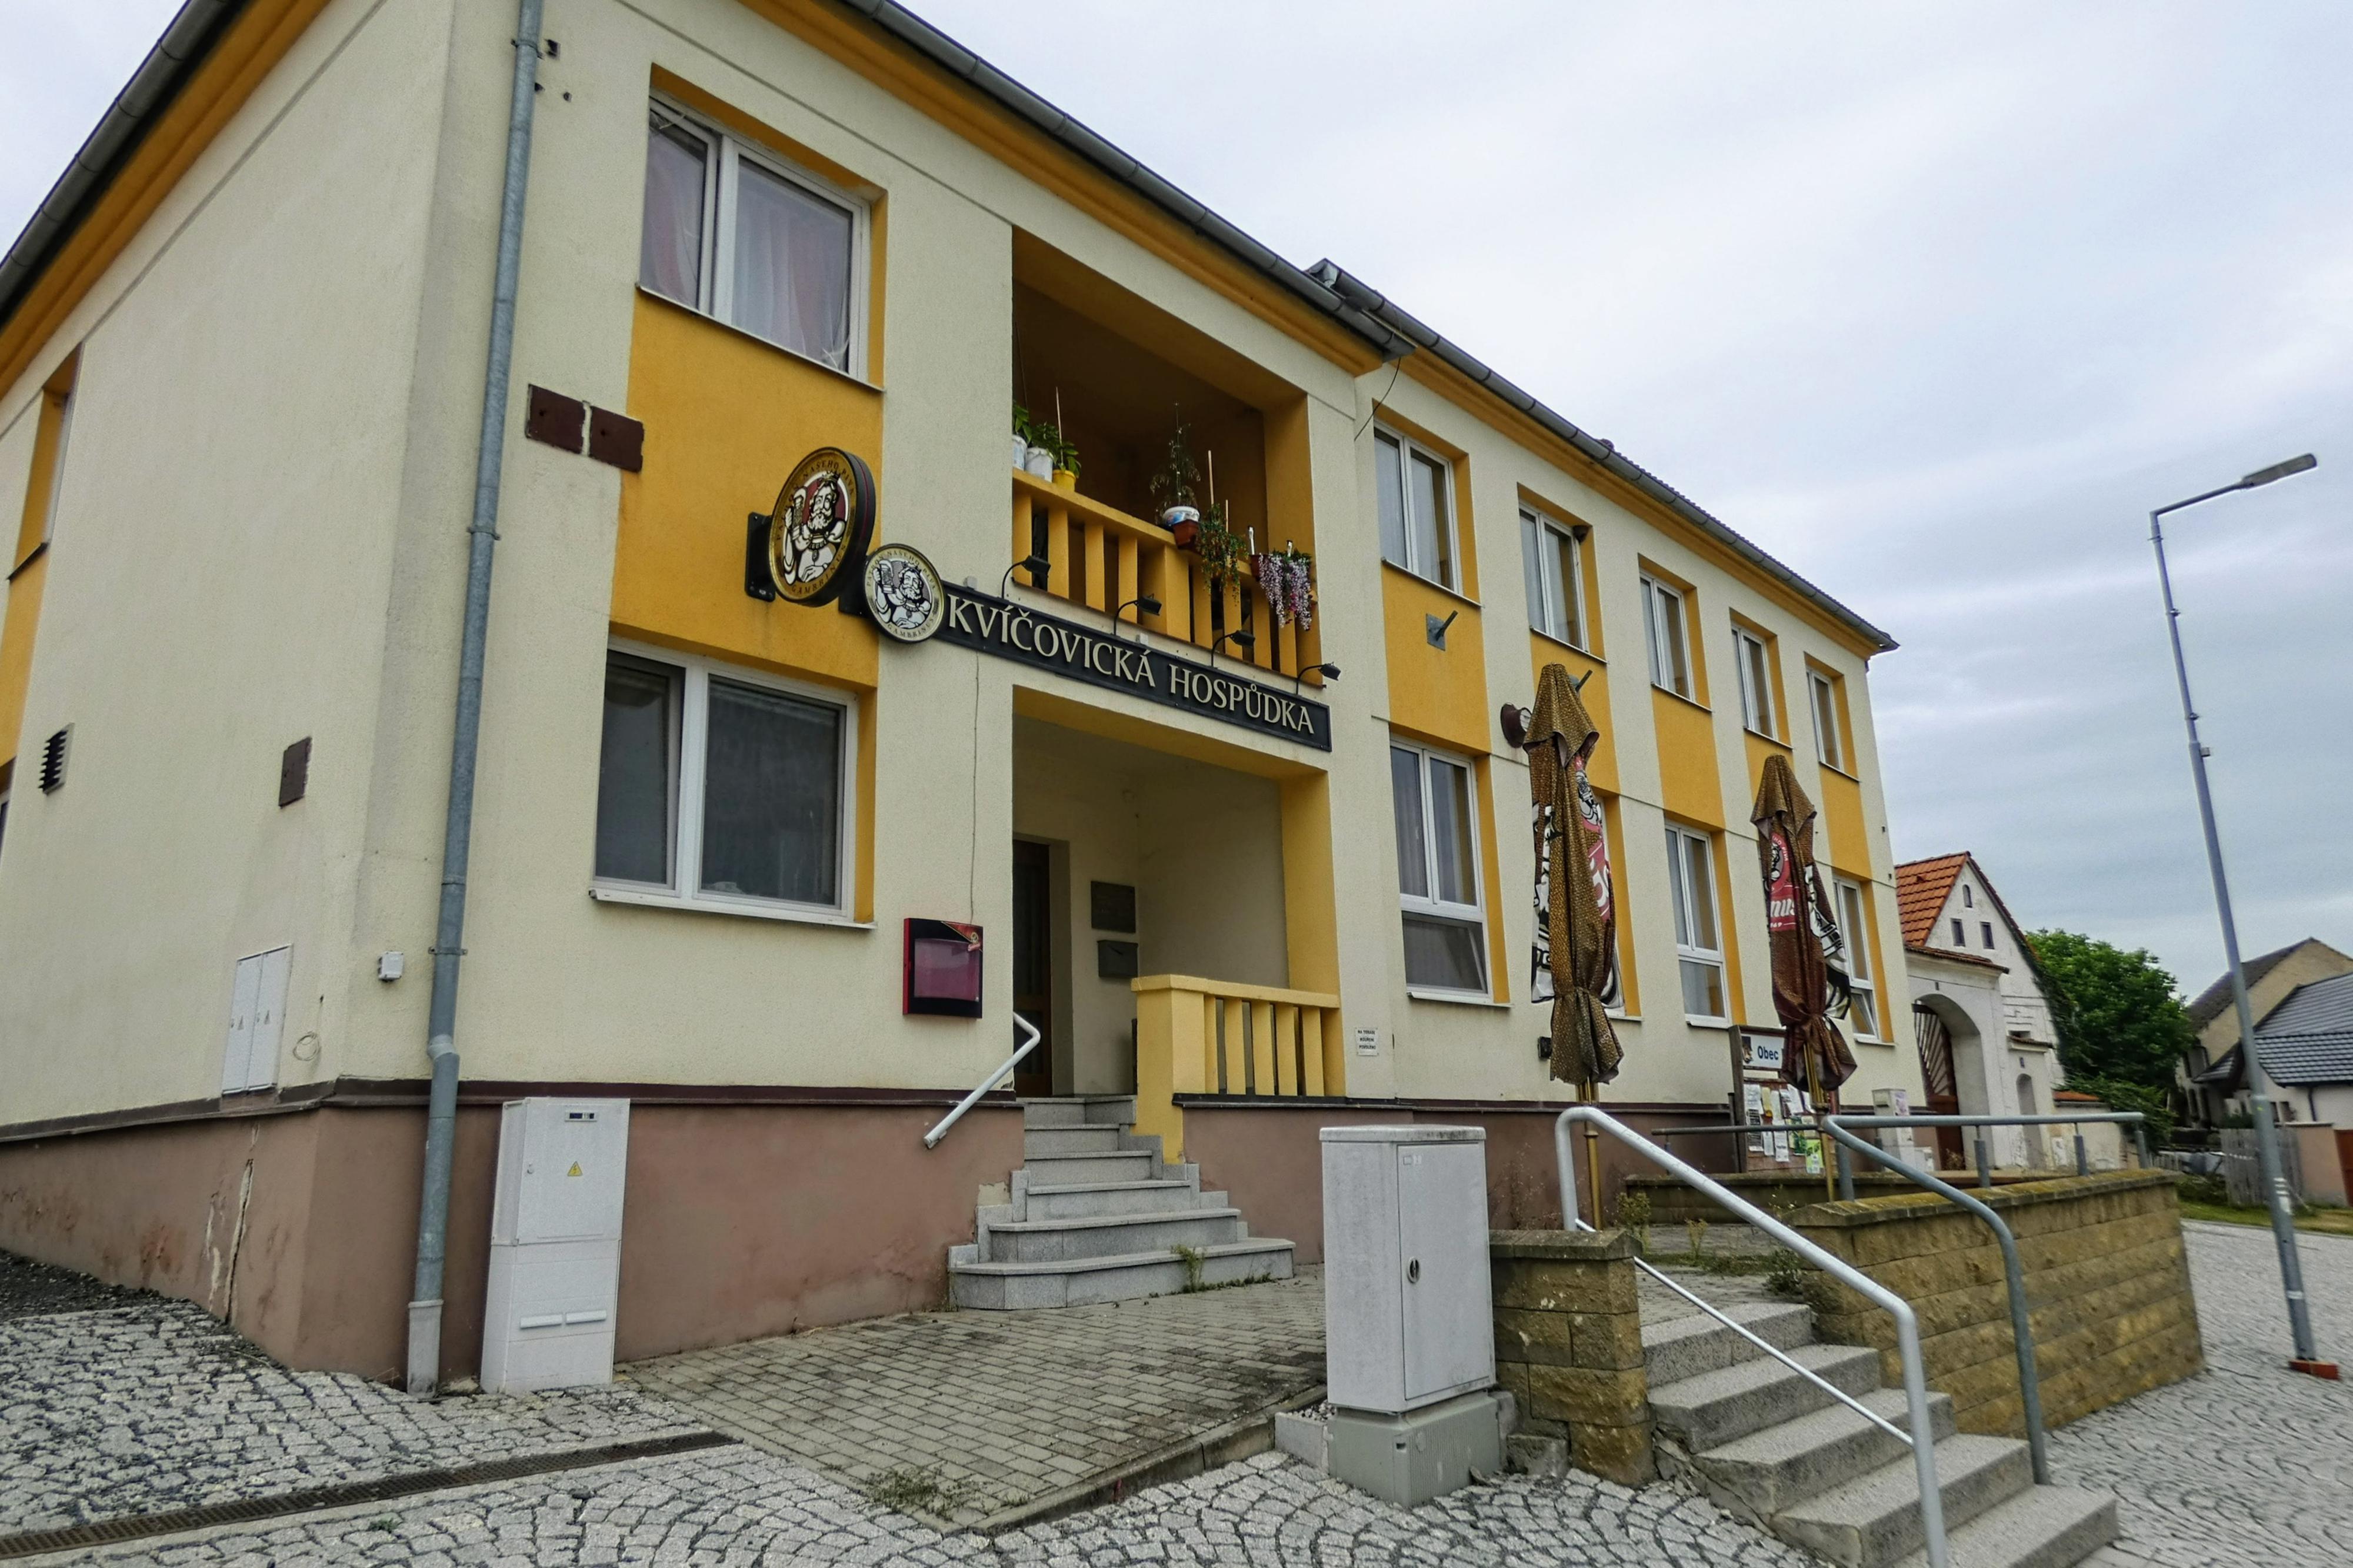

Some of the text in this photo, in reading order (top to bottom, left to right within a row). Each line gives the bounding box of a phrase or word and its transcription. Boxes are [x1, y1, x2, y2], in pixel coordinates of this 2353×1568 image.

[791, 545, 846, 595] GAMBRINUS
[887, 618, 934, 638] GAMBRINUS
[948, 593, 1315, 735] KVÍČOVICKÁ HOSPŮDKA
[1757, 1046, 1779, 1060] Obec
